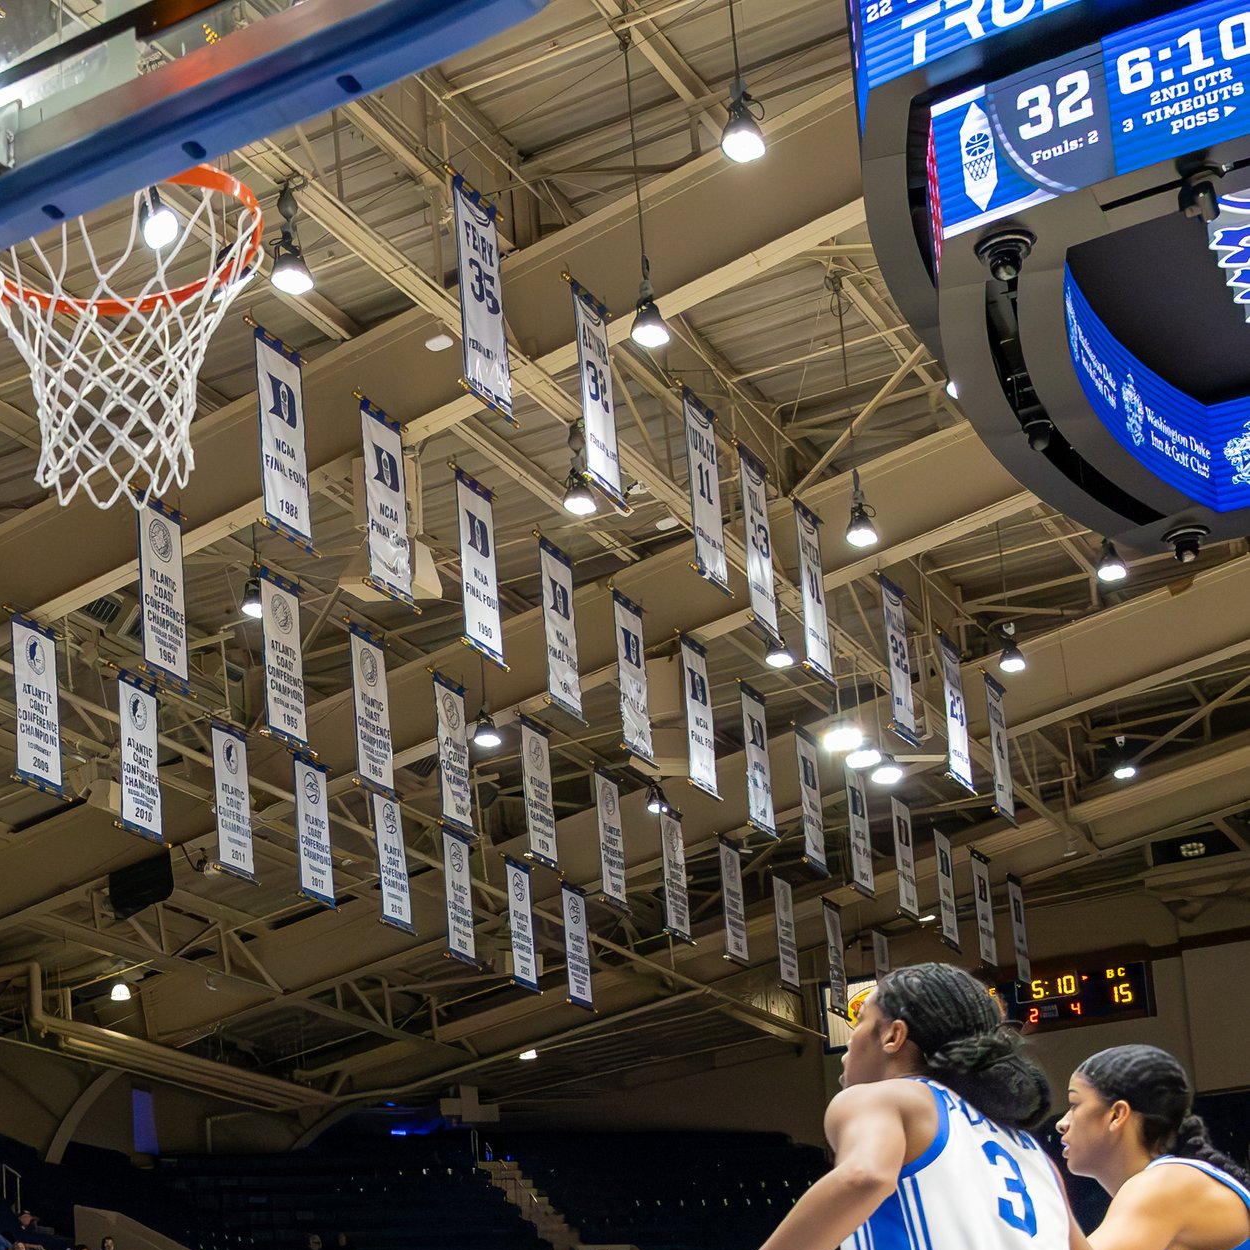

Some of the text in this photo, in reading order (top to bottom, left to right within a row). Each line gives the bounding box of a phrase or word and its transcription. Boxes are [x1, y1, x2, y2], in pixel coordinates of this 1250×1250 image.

[1116, 11, 1250, 95] 6:10
[1150, 68, 1234, 105] 2ND QTR
[1015, 69, 1094, 141] 32
[1122, 83, 1244, 133] 3 TIMEOUTS
[1170, 109, 1221, 135] POSS
[1030, 131, 1099, 166] Fouls: 2
[468, 257, 500, 315] 35
[1144, 405, 1211, 460] Washington Duke
[275, 437, 296, 461] NCAA
[1150, 430, 1164, 451] Inn
[1171, 445, 1190, 468] Golf
[1189, 456, 1210, 479] Club
[265, 454, 288, 478] FINAL
[697, 462, 714, 505] 11
[279, 499, 298, 520] 1988
[379, 502, 399, 524] NCAA
[150, 567, 177, 592] ATLANTIC
[473, 567, 489, 587] NCAA
[154, 584, 174, 604] COAST
[465, 582, 482, 602] FINAL
[144, 593, 184, 625] CONFERENCE
[147, 609, 184, 639] CHAMPIONS
[477, 621, 492, 639] 1990
[159, 647, 177, 666] 1964
[271, 639, 297, 661] ATLANTIC
[276, 654, 294, 672] COAST
[267, 664, 303, 691] CONFERENCE
[22, 682, 52, 705] ATLANTIC
[270, 678, 303, 704] CHAMPIONS
[361, 691, 384, 712] ATLANTIC
[29, 698, 49, 716] COAST
[364, 706, 381, 723] COAST
[950, 689, 964, 727] 23
[17, 707, 58, 735] CONFERENCE
[357, 715, 391, 740] CONFERENCE
[19, 723, 57, 748] CHAMPIONS
[126, 737, 153, 758] ATLANTIC
[360, 729, 391, 753] CHAMPIONS
[32, 756, 49, 773] 2009
[133, 751, 150, 769] COAST
[122, 760, 159, 786] CONFERENCE
[124, 775, 159, 798] CHAMPIONS
[221, 782, 245, 801] ATLANTIC
[134, 806, 153, 823] 2010
[218, 805, 251, 828] CONFERENCE
[304, 813, 326, 830] ATLANTIC
[231, 849, 246, 863] 2011
[1031, 975, 1076, 1000] 5:10
[1112, 983, 1133, 1003] 15
[1029, 1008, 1039, 1023] 2
[1070, 1002, 1081, 1016] 4
[982, 1141, 1037, 1238] 3
